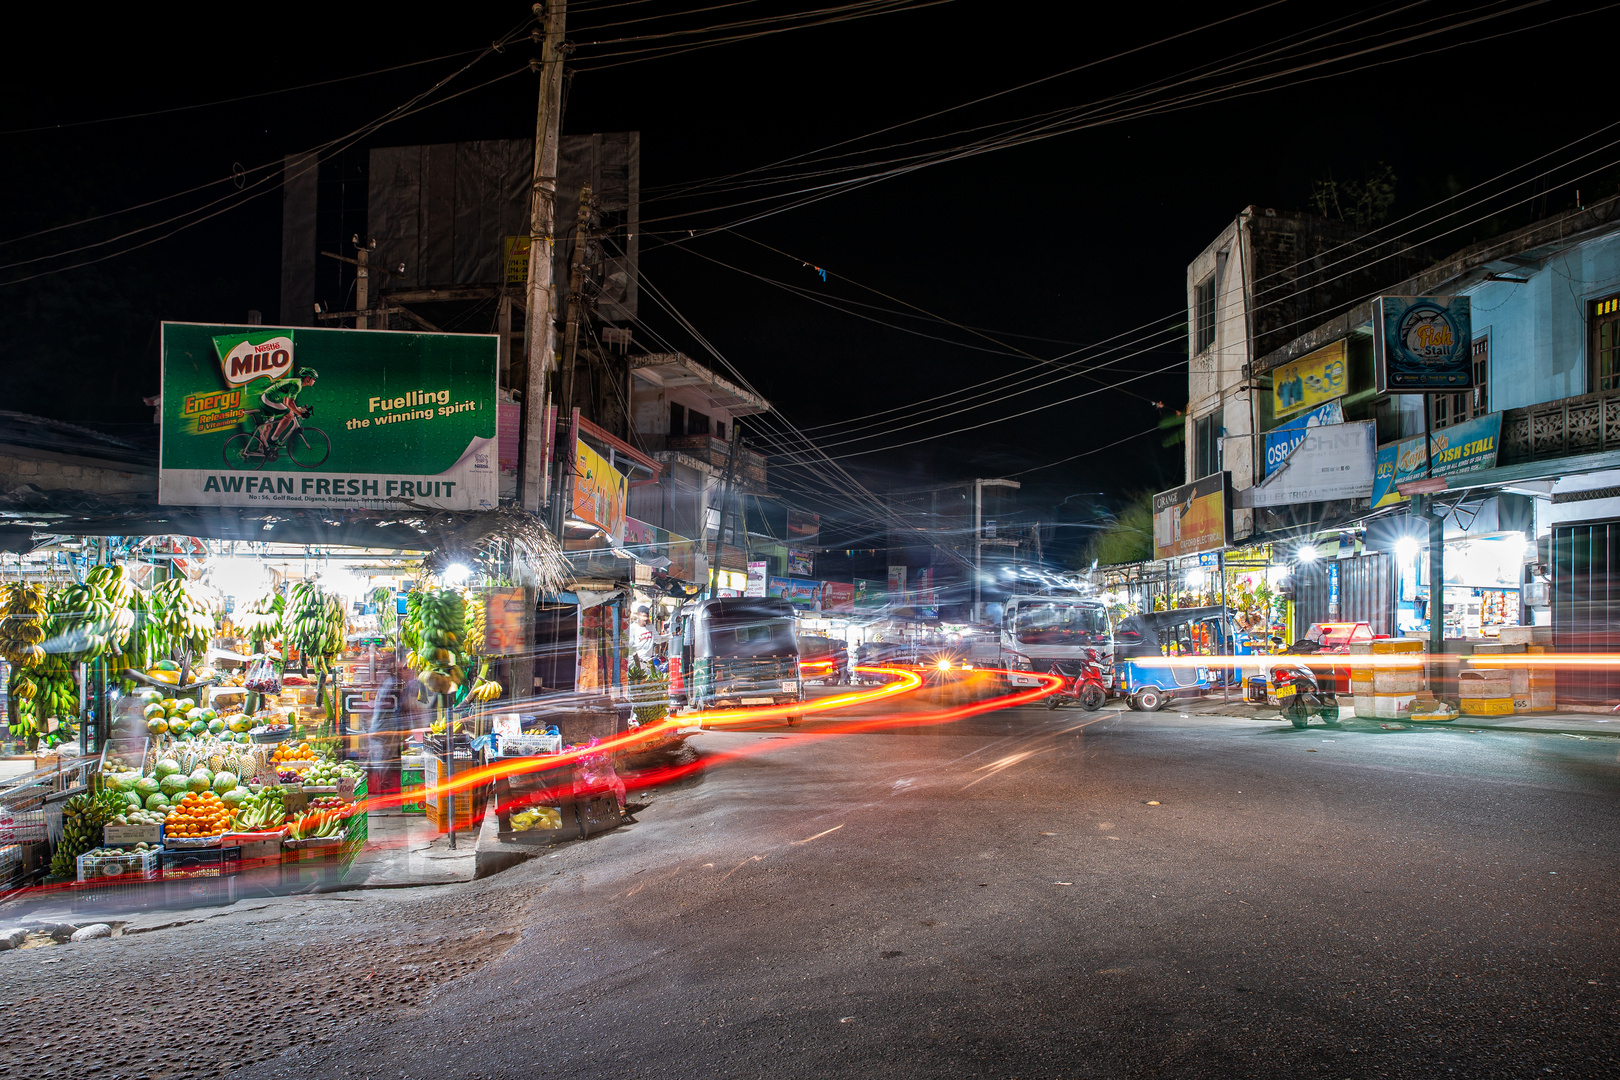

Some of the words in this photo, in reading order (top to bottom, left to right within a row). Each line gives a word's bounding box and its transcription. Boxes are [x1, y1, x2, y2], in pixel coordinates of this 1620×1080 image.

[1417, 325, 1454, 348] Fish
[1425, 346, 1450, 355] Stall
[231, 349, 290, 377] MILO
[185, 391, 241, 414] Energy
[369, 390, 450, 413] Fuelling
[199, 409, 245, 424] Releasing
[205, 418, 237, 429] Vitamins
[346, 418, 371, 430] the
[375, 409, 434, 426] winning
[438, 400, 476, 417] spirit
[1400, 434, 1449, 468] Rajaella
[1463, 436, 1494, 457] STALL
[1377, 461, 1393, 475] RFS
[203, 475, 294, 494] AWFAN
[301, 478, 378, 496] FRESH
[386, 480, 456, 498] FRUIT
[1180, 538, 1197, 549] OXFORD
[1197, 532, 1223, 545] ELECTRICAL
